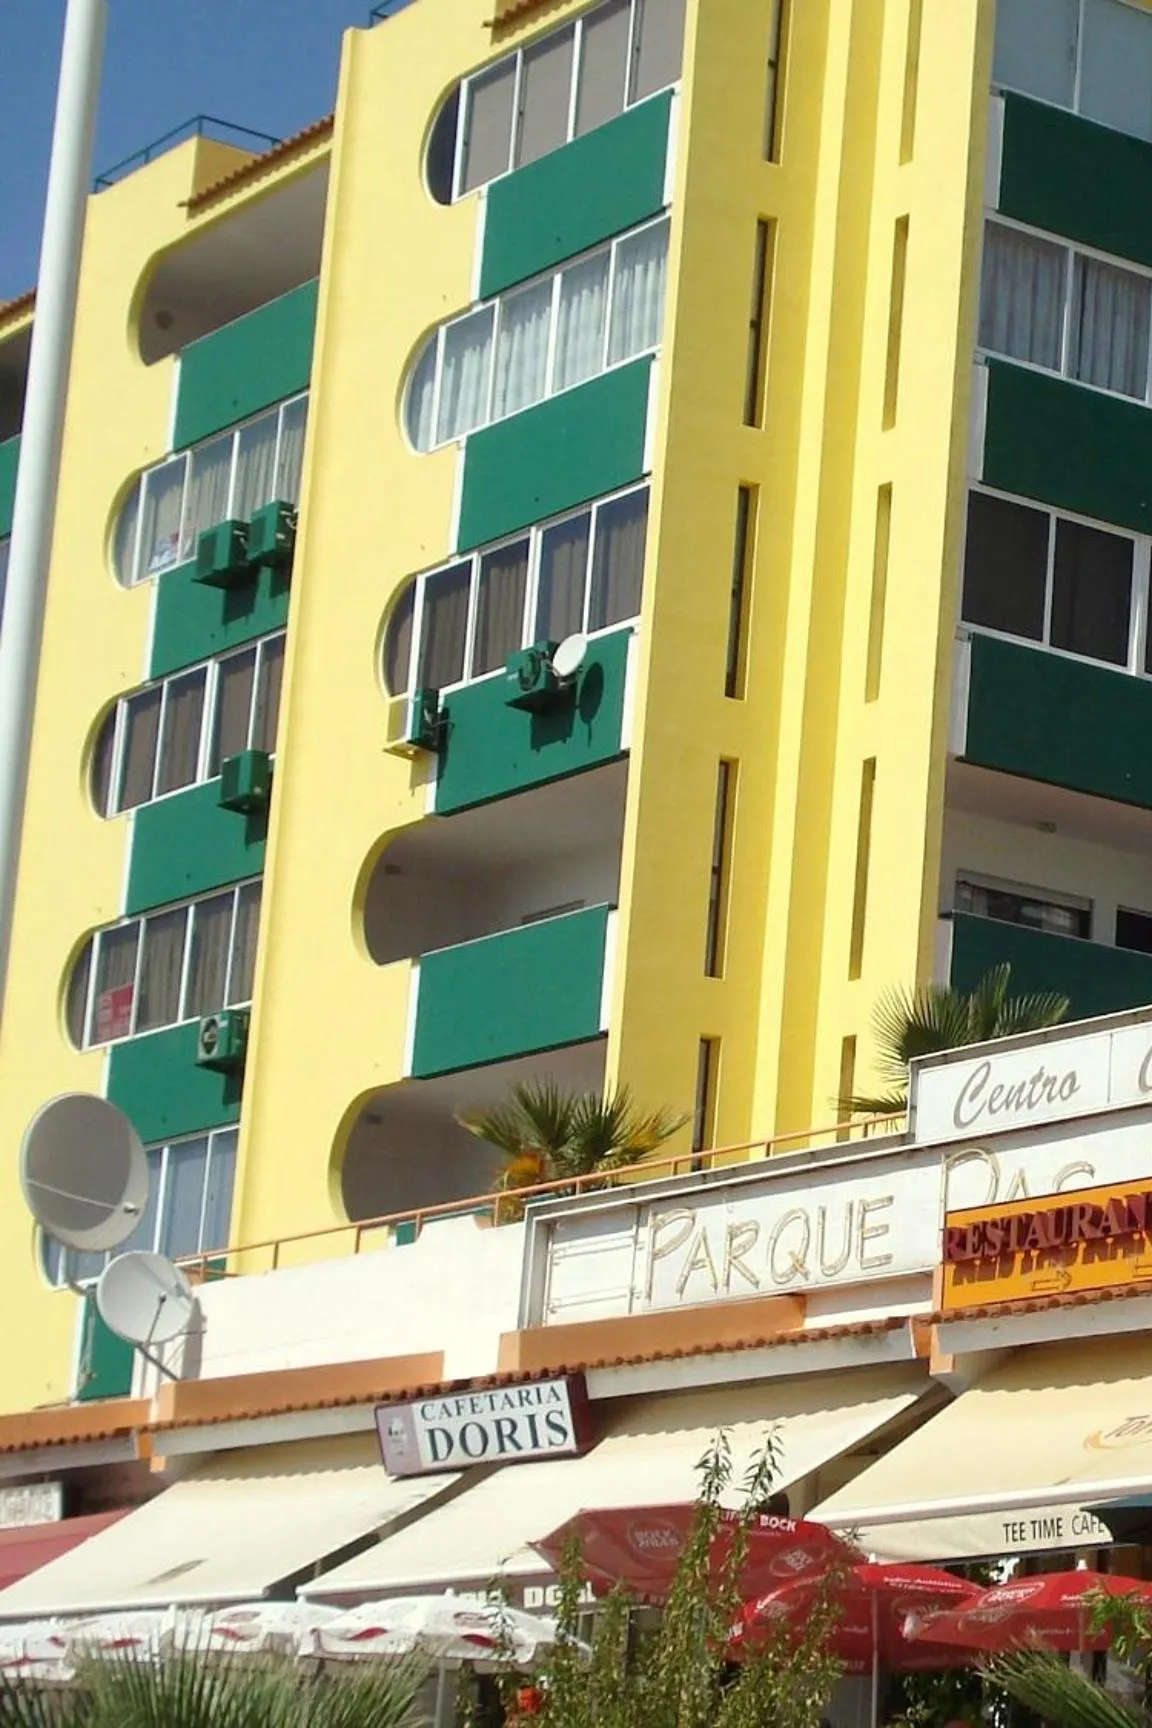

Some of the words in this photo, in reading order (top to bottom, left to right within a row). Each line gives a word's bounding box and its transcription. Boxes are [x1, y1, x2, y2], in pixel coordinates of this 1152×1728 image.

[952, 1062, 1080, 1130] Centro
[647, 1195, 895, 1301] PARQUE
[420, 1384, 562, 1422] CAFETARIA
[425, 1409, 569, 1463] DORIS
[759, 1514, 797, 1533] BOCK
[1002, 1521, 1026, 1544] TEE
[1030, 1517, 1063, 1542] TIME
